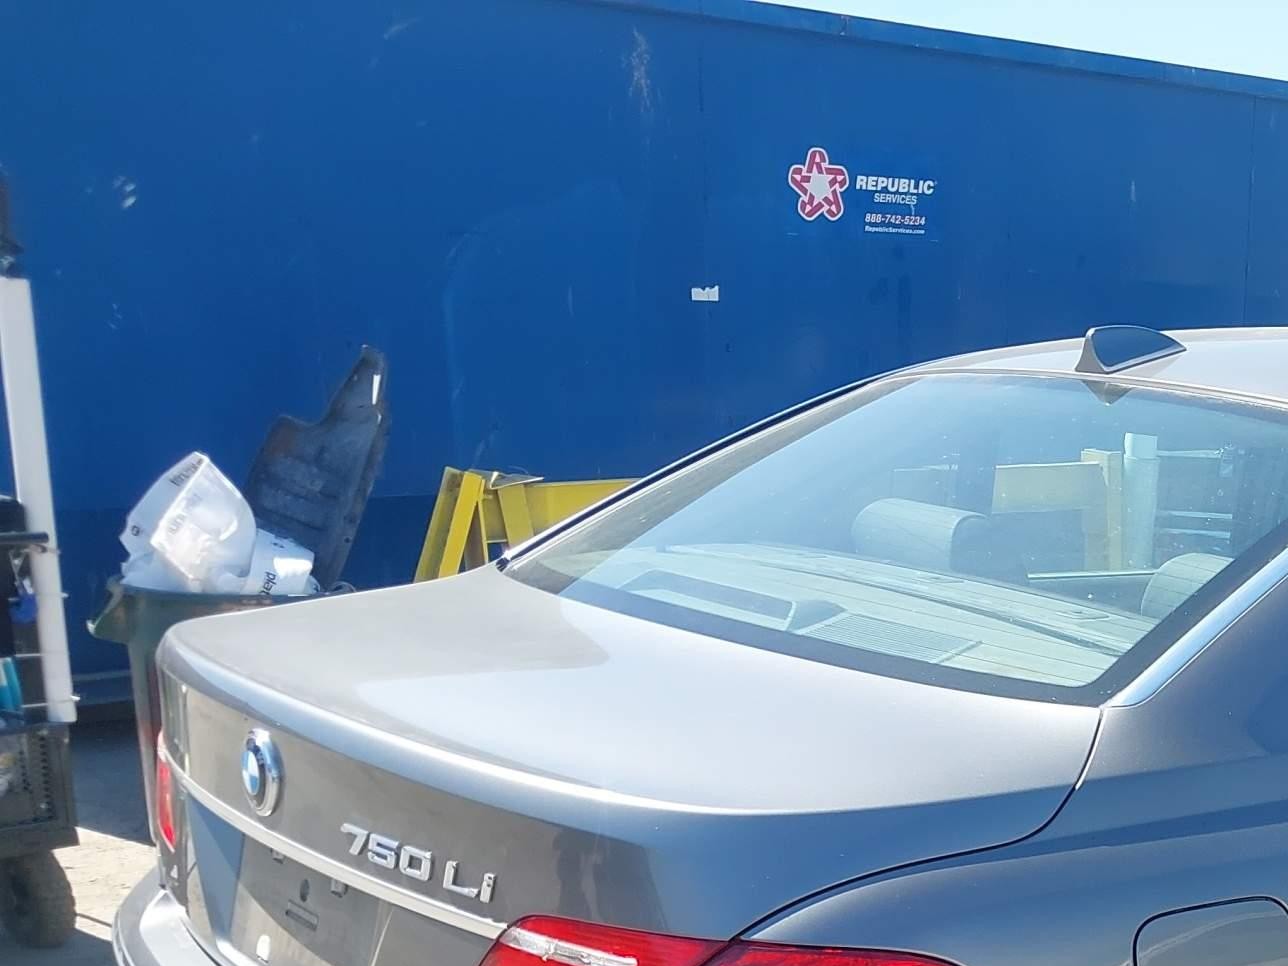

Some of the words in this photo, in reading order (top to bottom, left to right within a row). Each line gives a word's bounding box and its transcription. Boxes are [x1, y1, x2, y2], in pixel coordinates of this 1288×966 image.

[855, 175, 935, 195] REPUBLIC
[873, 192, 918, 205] SERVICES
[864, 213, 926, 226] 888-742-5234
[340, 823, 432, 882] 750
[442, 860, 497, 904] Li
